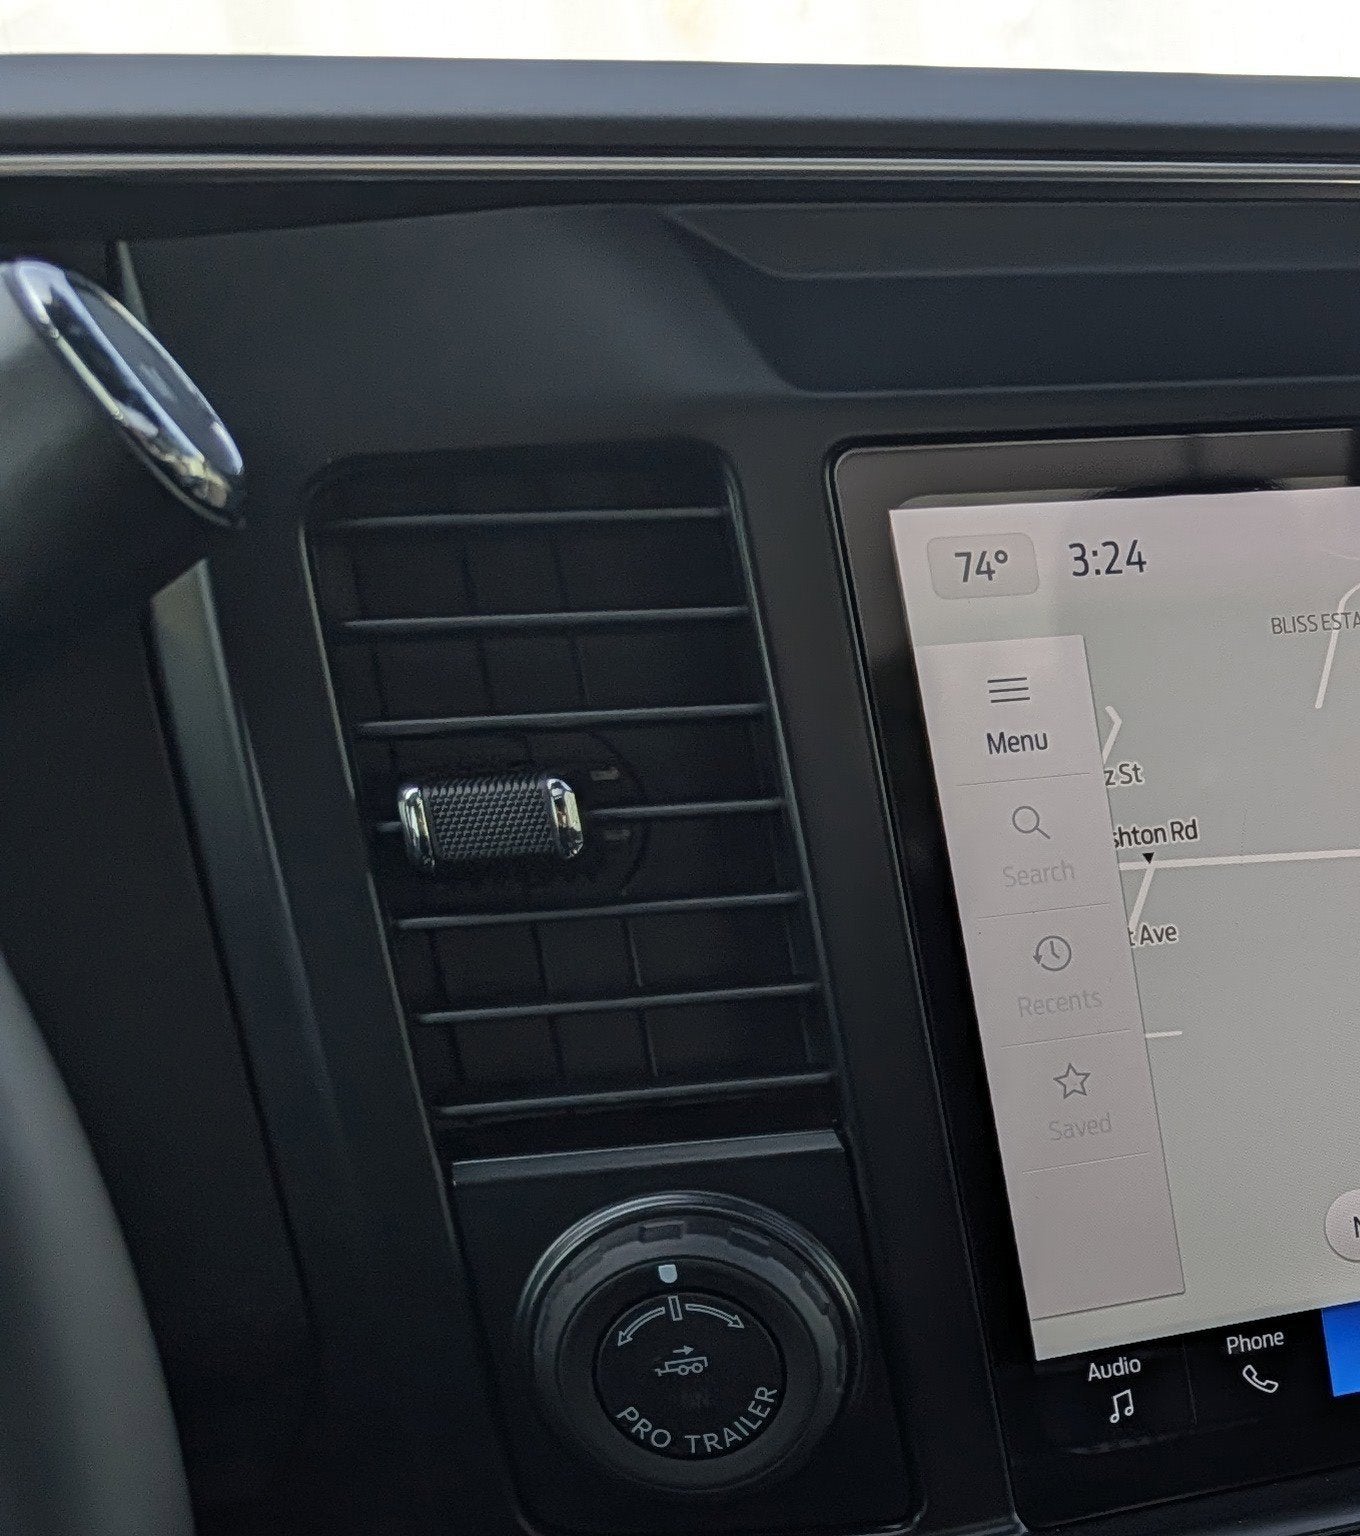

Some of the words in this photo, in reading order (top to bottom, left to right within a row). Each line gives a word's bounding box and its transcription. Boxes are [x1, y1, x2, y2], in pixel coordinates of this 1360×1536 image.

[1068, 539, 1147, 577] 3:24
[1270, 613, 1318, 635] BLISS
[986, 731, 1048, 754] Menu
[1120, 763, 1142, 784] St
[1170, 819, 1198, 841] Rd
[1003, 860, 1075, 889] Search
[1140, 924, 1177, 945] Ave
[1017, 989, 1102, 1018] Recents
[1049, 1112, 1112, 1141] Saved
[1226, 1329, 1284, 1354] Phone
[1087, 1355, 1141, 1382] Audio
[616, 1406, 671, 1449] PRO
[685, 1386, 778, 1454] TRAILER
